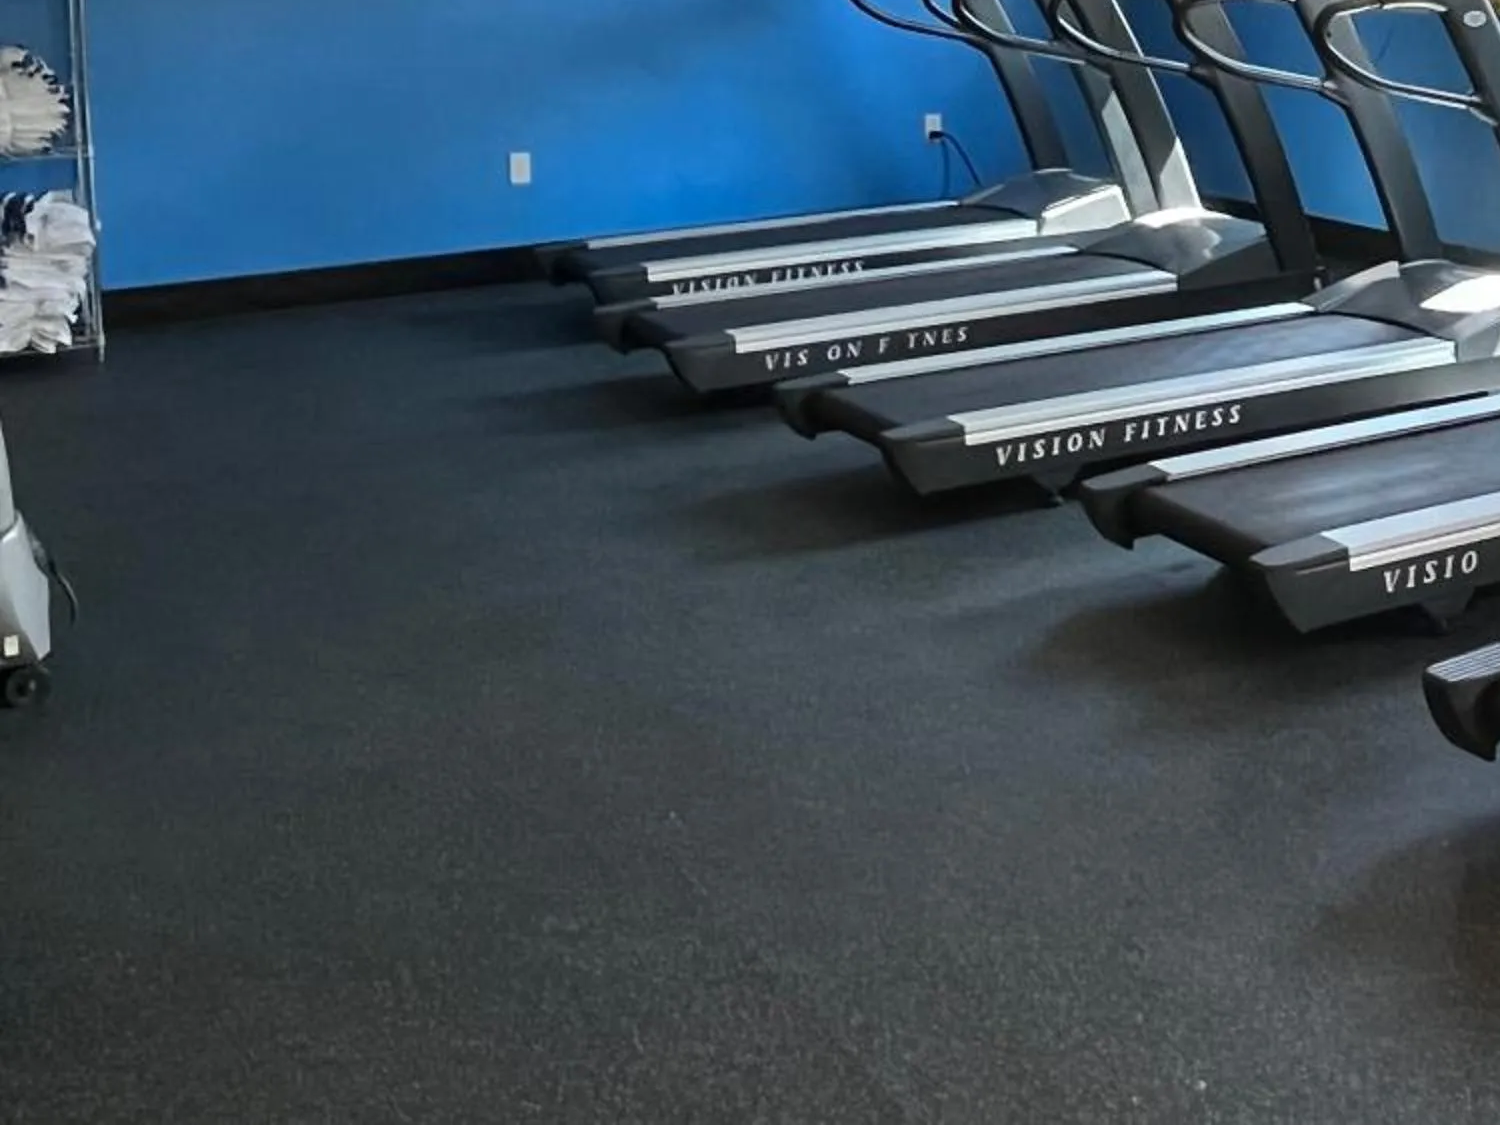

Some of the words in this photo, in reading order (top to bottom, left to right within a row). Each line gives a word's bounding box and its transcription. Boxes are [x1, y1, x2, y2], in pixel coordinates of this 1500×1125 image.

[673, 273, 757, 295] VISION
[772, 260, 864, 283] FITNESS
[996, 428, 1106, 466] VISION
[1124, 404, 1242, 442] FITNESS
